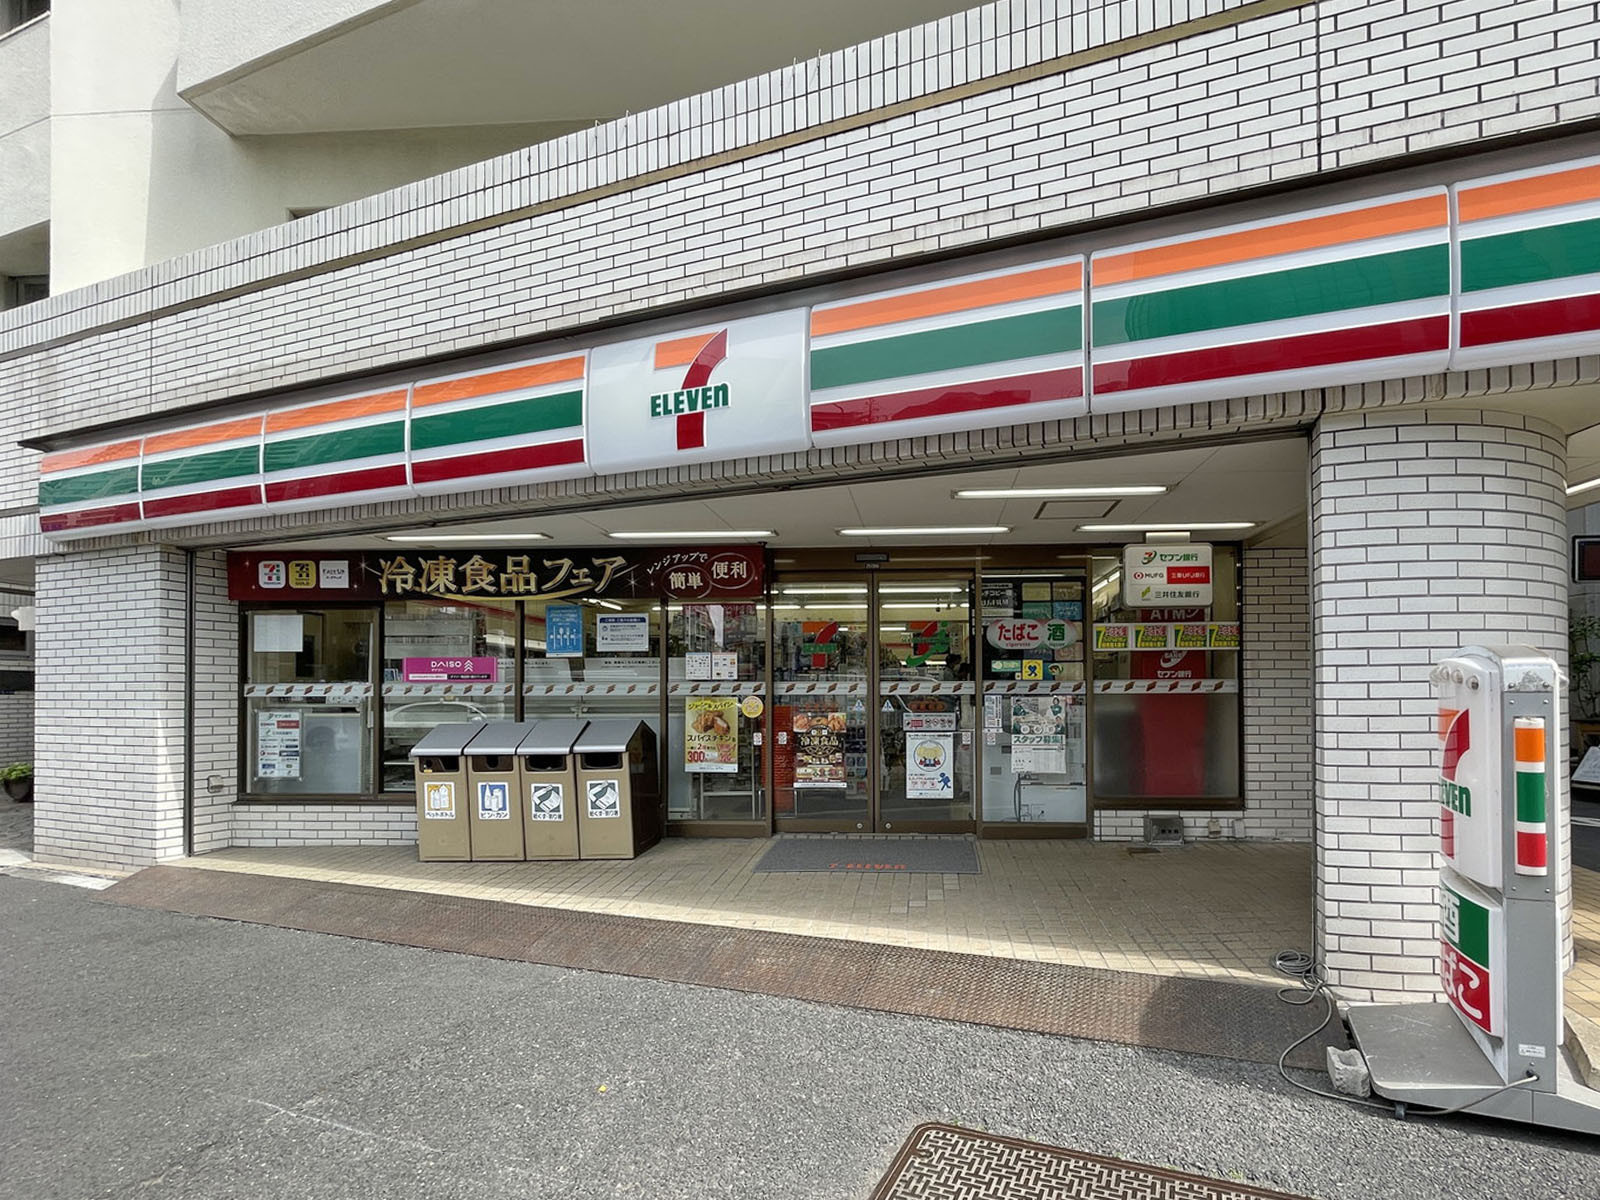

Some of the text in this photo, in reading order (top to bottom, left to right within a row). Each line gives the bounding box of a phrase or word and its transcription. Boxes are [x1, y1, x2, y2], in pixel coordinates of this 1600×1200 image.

[646, 552, 709, 575] レンジアップで
[1159, 552, 1199, 563] セブン銀行
[378, 554, 627, 595] 冷凍食品フェア
[711, 561, 748, 580] 便利
[669, 571, 704, 591] 簡単
[1154, 590, 1200, 599] 三井住友銀行
[997, 622, 1039, 641] たばこ
[1047, 623, 1065, 641] 酒
[1156, 670, 1192, 678] セブン銀行
[687, 750, 705, 763] 300
[426, 810, 455, 818] ペットボトル
